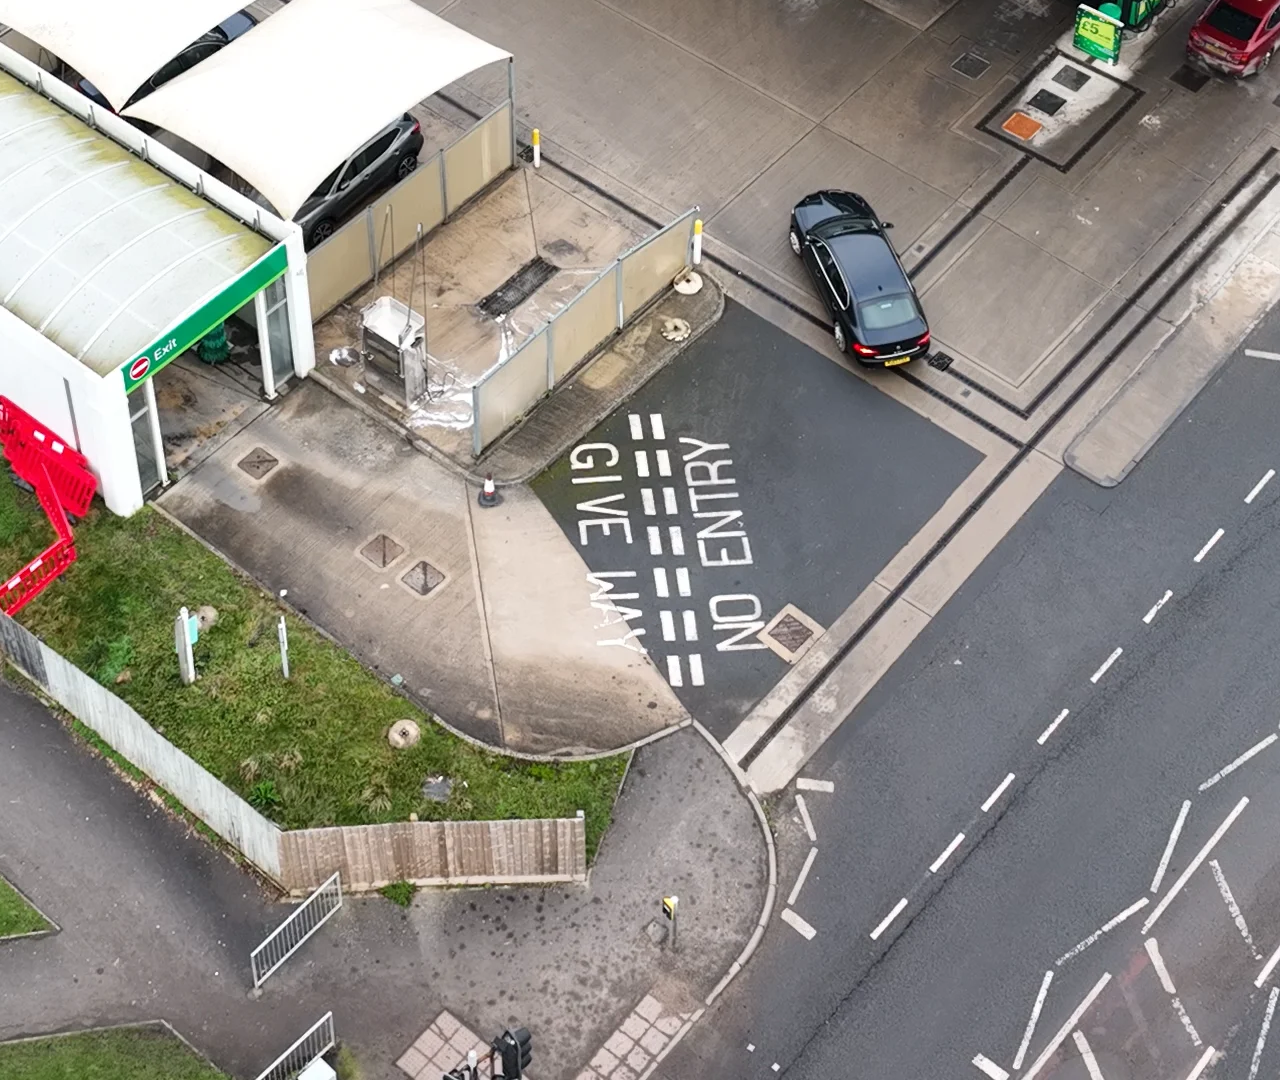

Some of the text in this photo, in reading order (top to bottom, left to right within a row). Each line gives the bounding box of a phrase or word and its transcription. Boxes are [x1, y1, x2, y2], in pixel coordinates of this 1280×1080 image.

[1081, 20, 1100, 35] £5
[154, 338, 178, 361] Exit
[570, 442, 649, 655] GIVE WAY
[678, 436, 770, 652] NO ENTRY
